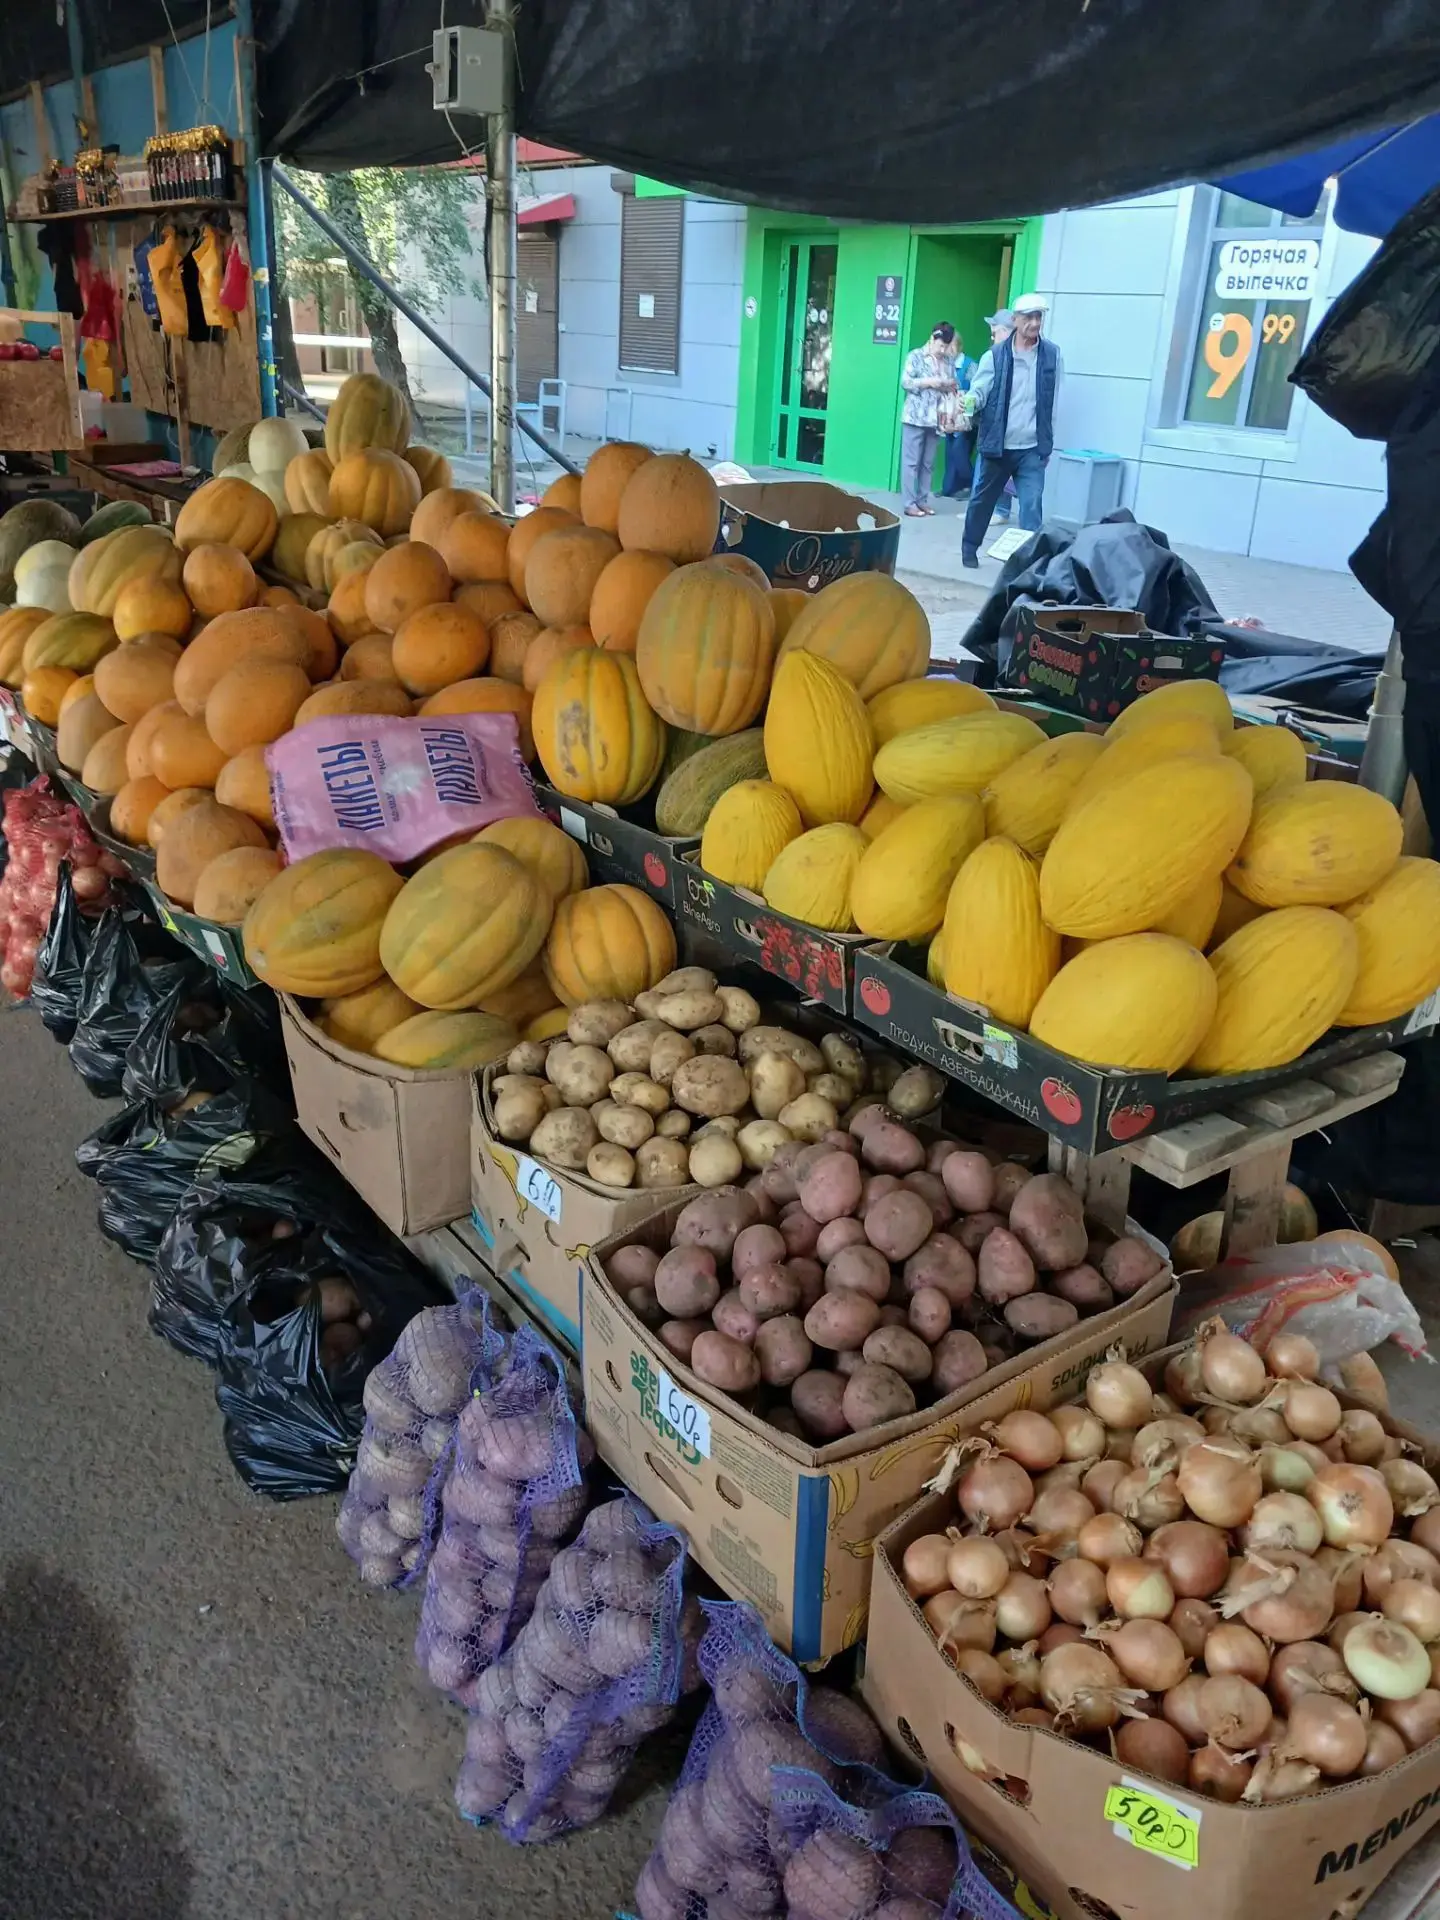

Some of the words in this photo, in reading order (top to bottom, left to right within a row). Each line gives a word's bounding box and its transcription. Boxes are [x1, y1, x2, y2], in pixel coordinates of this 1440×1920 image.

[1230, 245, 1307, 268] Горячая
[1226, 274, 1309, 291] выпечка
[875, 304, 900, 321] 8-22
[316, 740, 386, 832] ПАКЕТЫ
[420, 727, 483, 805] ПАКЕТЫ
[889, 1021, 938, 1059] ПРОДУКТ
[940, 1053, 1040, 1121] АЗЕРБАЙДЖАНА
